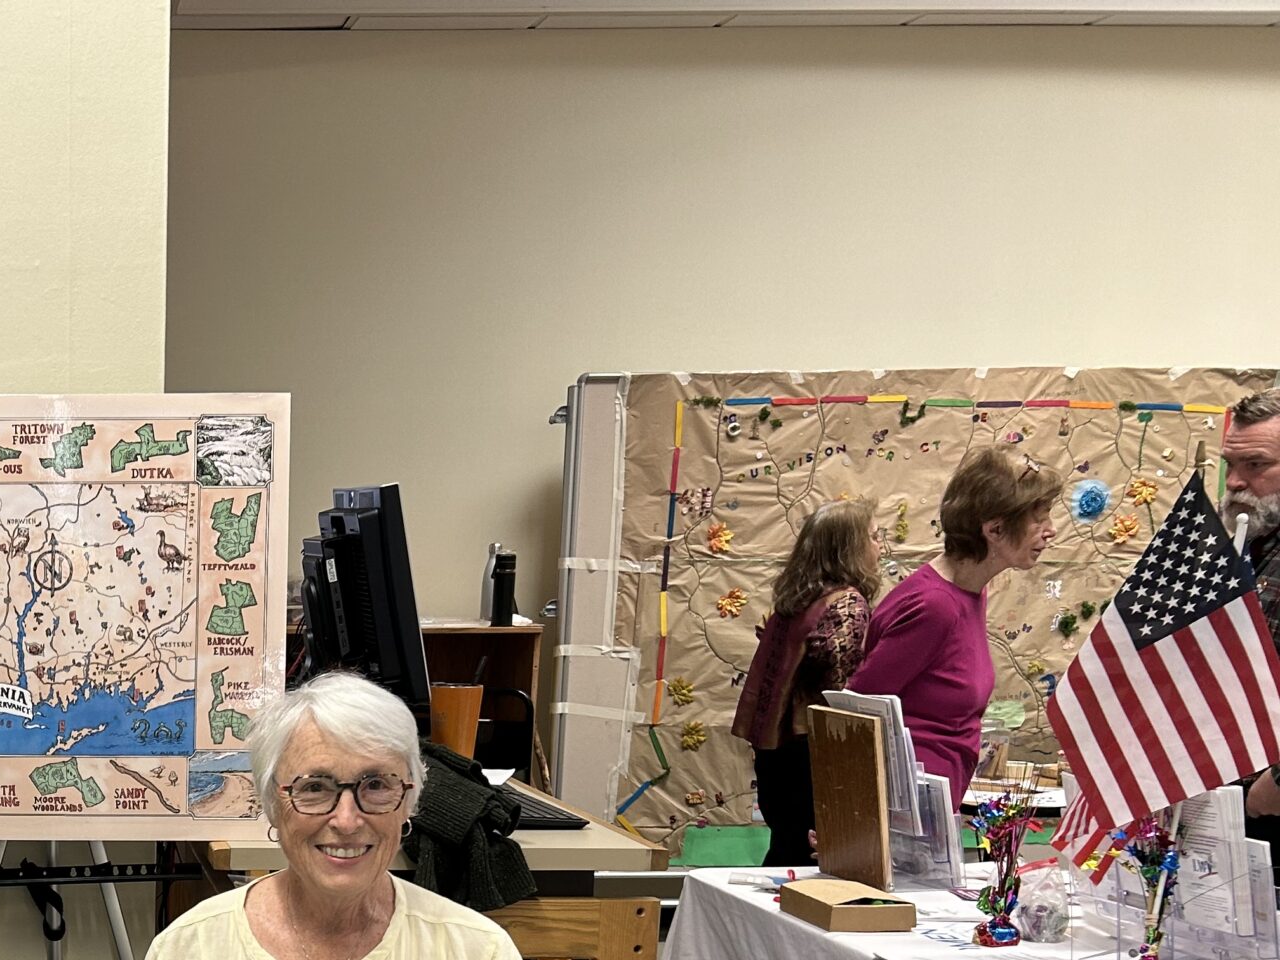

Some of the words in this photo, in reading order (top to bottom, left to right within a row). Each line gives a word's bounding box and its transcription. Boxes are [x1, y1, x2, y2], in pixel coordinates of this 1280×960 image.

[12, 423, 64, 434] TRITOWN
[13, 435, 48, 445] FOREST
[131, 467, 174, 479] DUTKA
[213, 646, 254, 656] ERISMAN
[227, 681, 250, 690] PIKE
[114, 787, 147, 799] SANDY
[34, 796, 67, 804] MOORE
[115, 800, 149, 810] POINT
